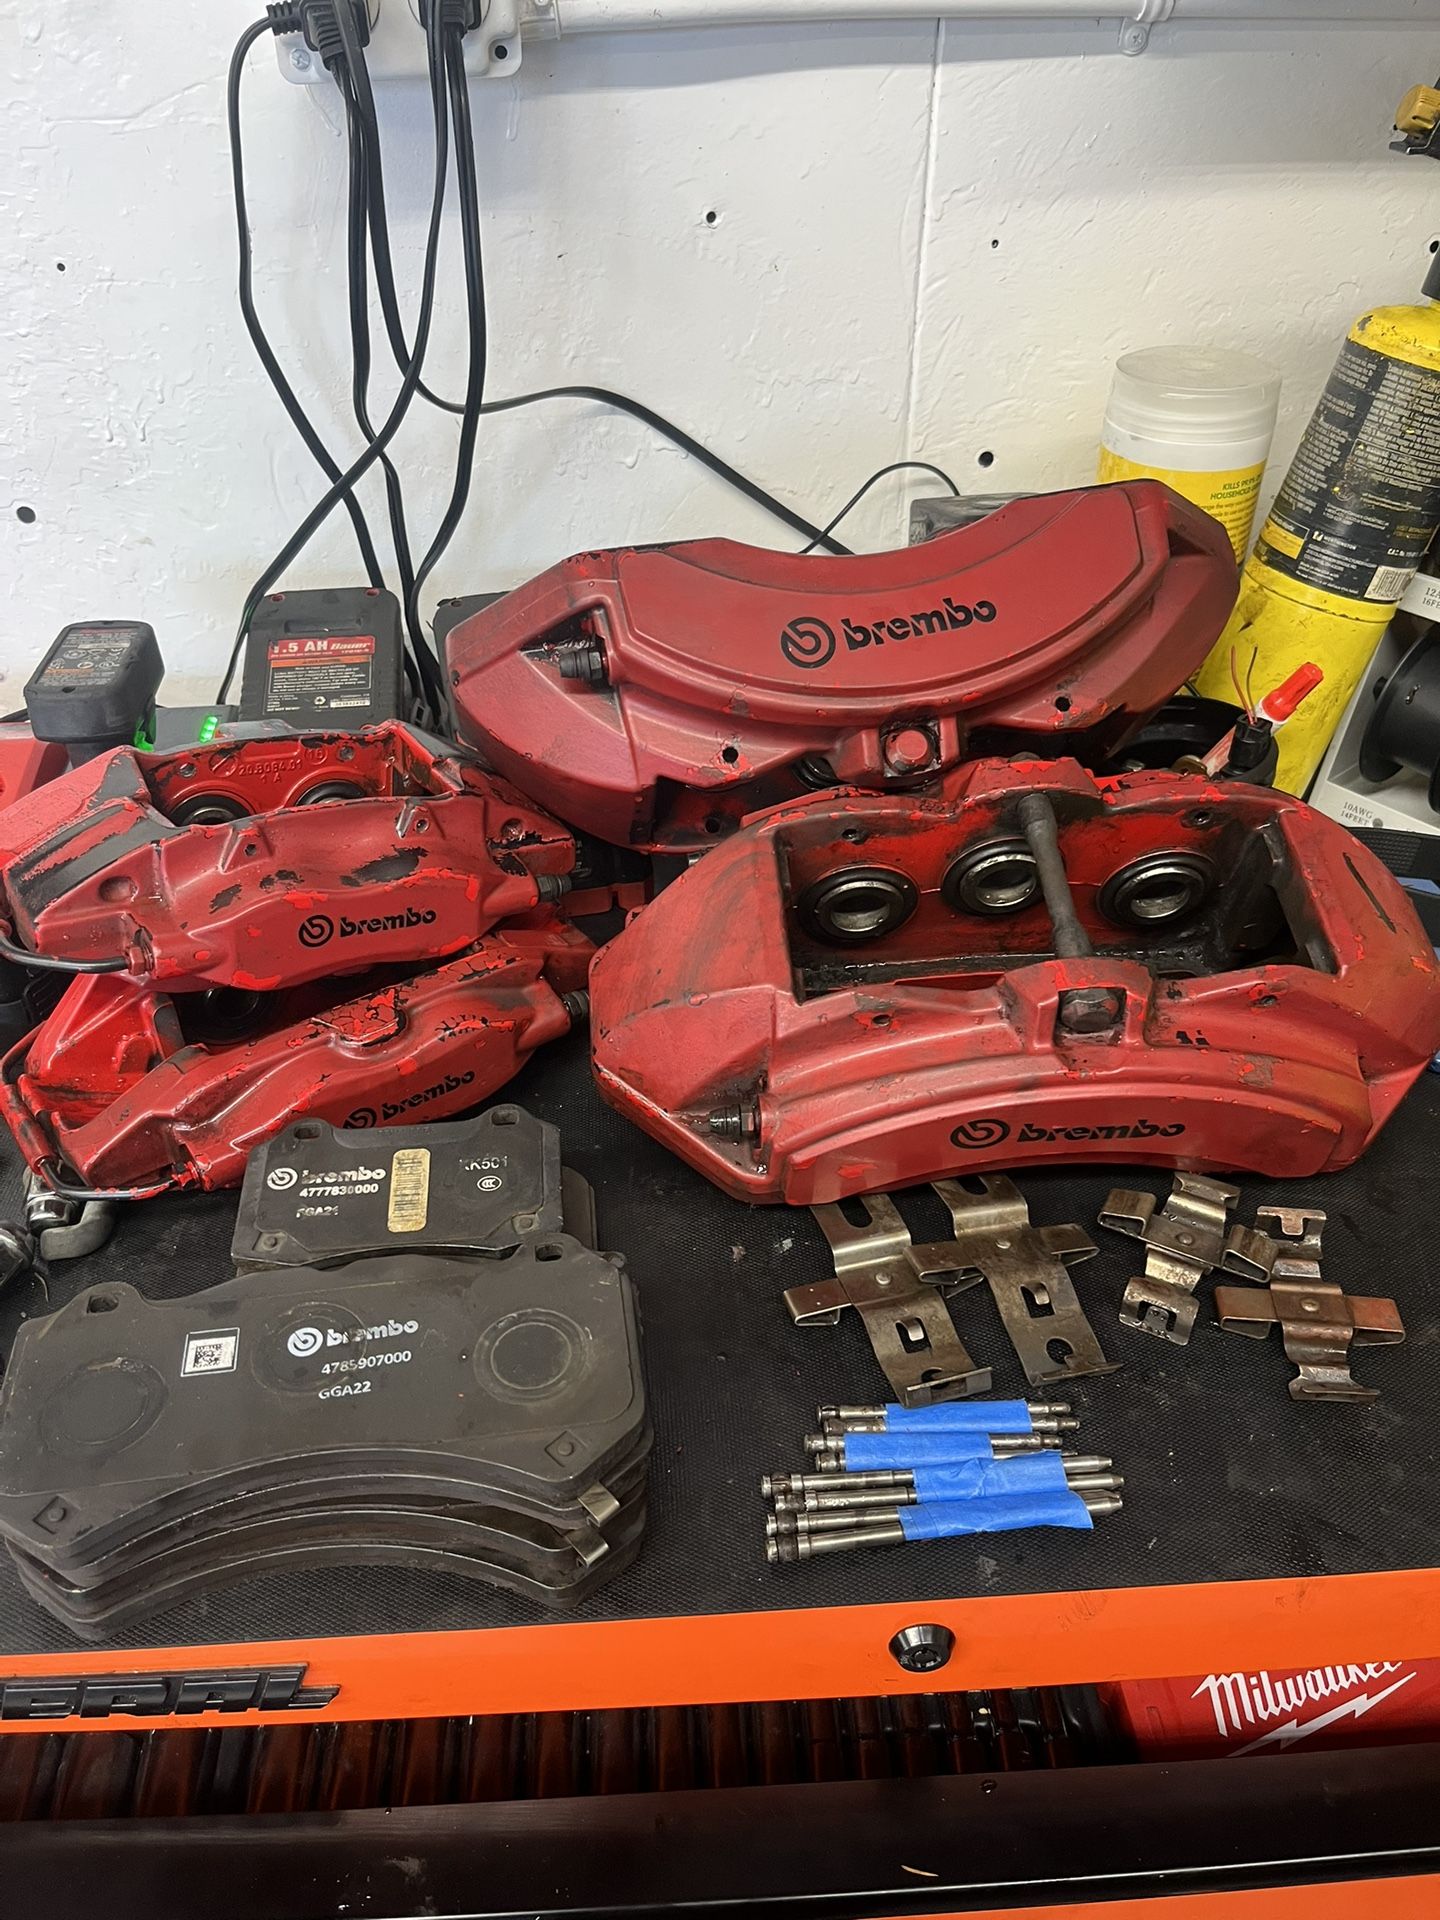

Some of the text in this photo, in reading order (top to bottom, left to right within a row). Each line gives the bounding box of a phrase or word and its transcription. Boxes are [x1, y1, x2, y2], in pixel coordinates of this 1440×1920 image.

[840, 597, 997, 650] brembo
[304, 640, 328, 651] AH
[1340, 810, 1370, 827] 14FEET
[1343, 801, 1374, 819] 10AWG
[340, 907, 437, 938] brembo
[381, 1070, 475, 1120] brembo
[1017, 1119, 1186, 1143] brembo
[302, 1166, 386, 1185] brembo
[299, 1183, 379, 1198] 4777830000
[326, 1319, 419, 1347] brembo
[321, 1350, 412, 1375] 4785907000
[318, 1380, 372, 1400] GGA22
